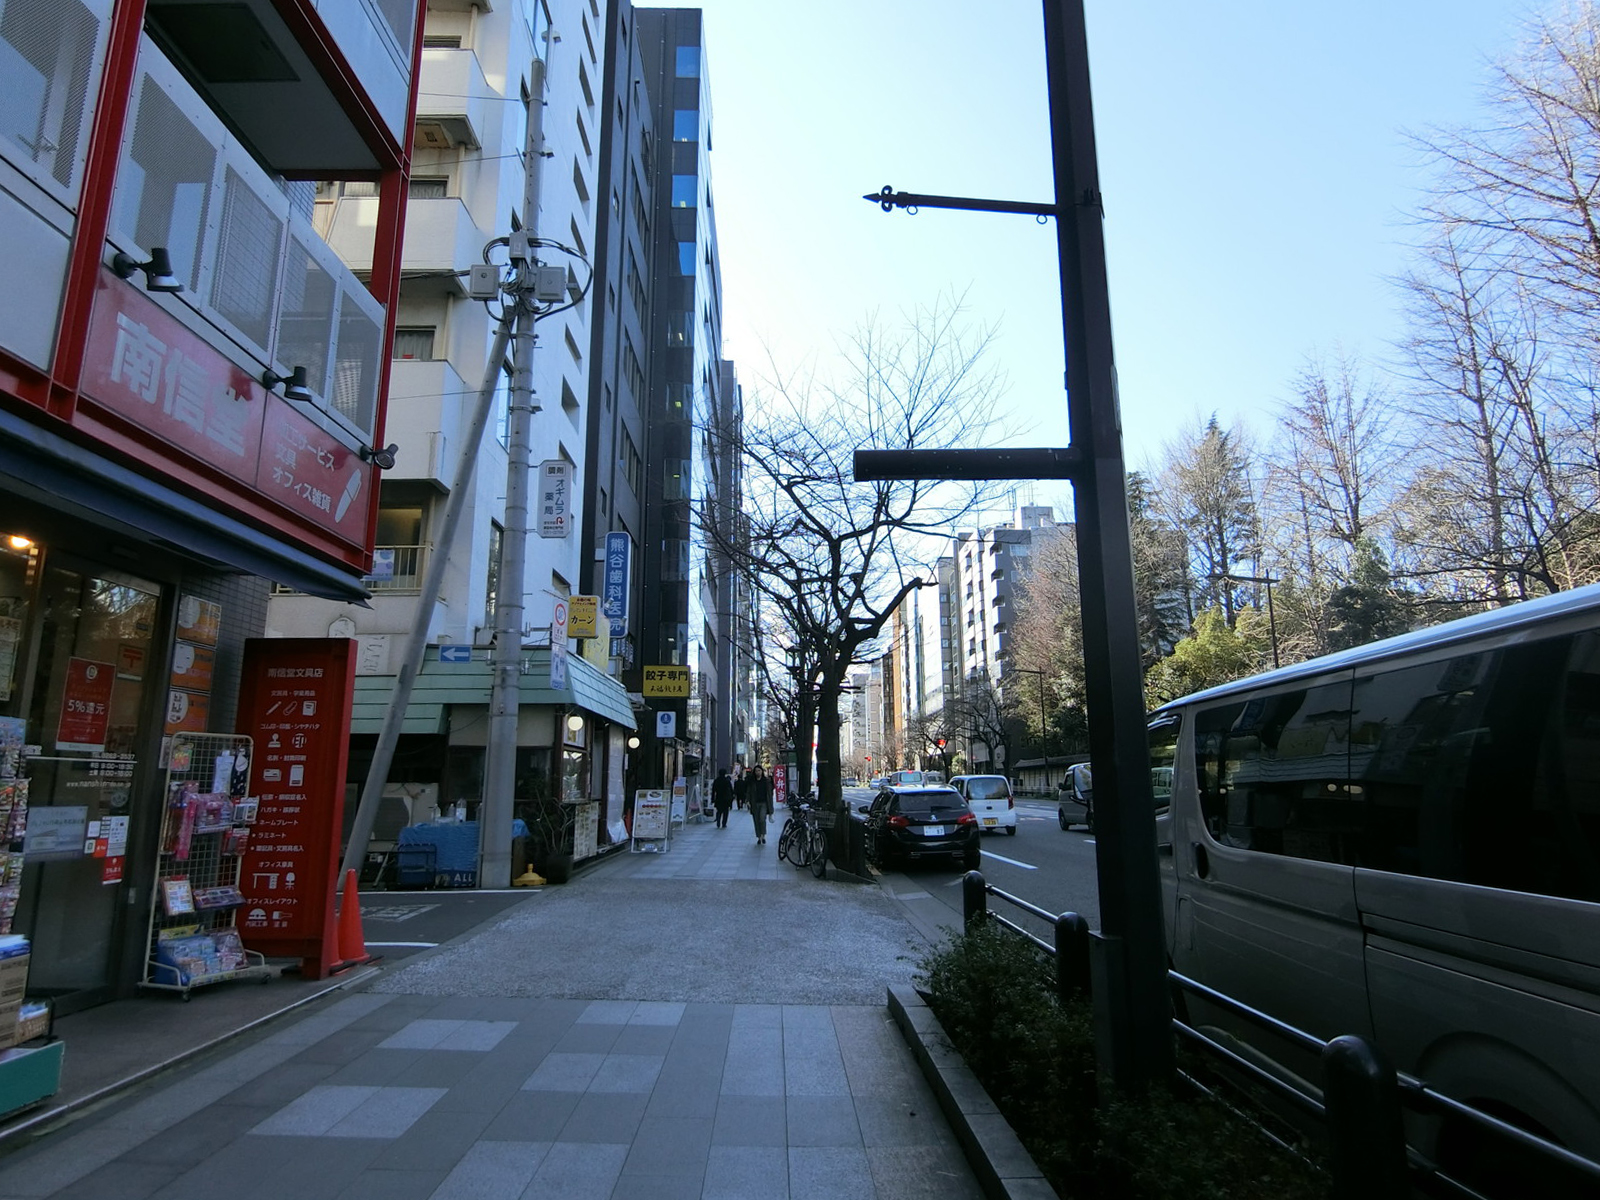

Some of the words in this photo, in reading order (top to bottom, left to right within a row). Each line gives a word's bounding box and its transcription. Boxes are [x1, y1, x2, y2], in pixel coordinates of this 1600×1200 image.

[111, 311, 246, 457] 南信堂
[275, 442, 296, 470] 文具
[273, 466, 332, 513] オフィス雑貨
[555, 479, 565, 515] オギムラ
[544, 492, 554, 515] 薬局
[608, 538, 625, 631] 熊谷歯科医院
[570, 615, 595, 625] カーン
[267, 668, 324, 678] 南信堂文具店
[645, 670, 688, 681] 餃子専門
[67, 700, 105, 715] 5%還元
[776, 768, 785, 800] お弁当
[453, 873, 472, 882] ALL
